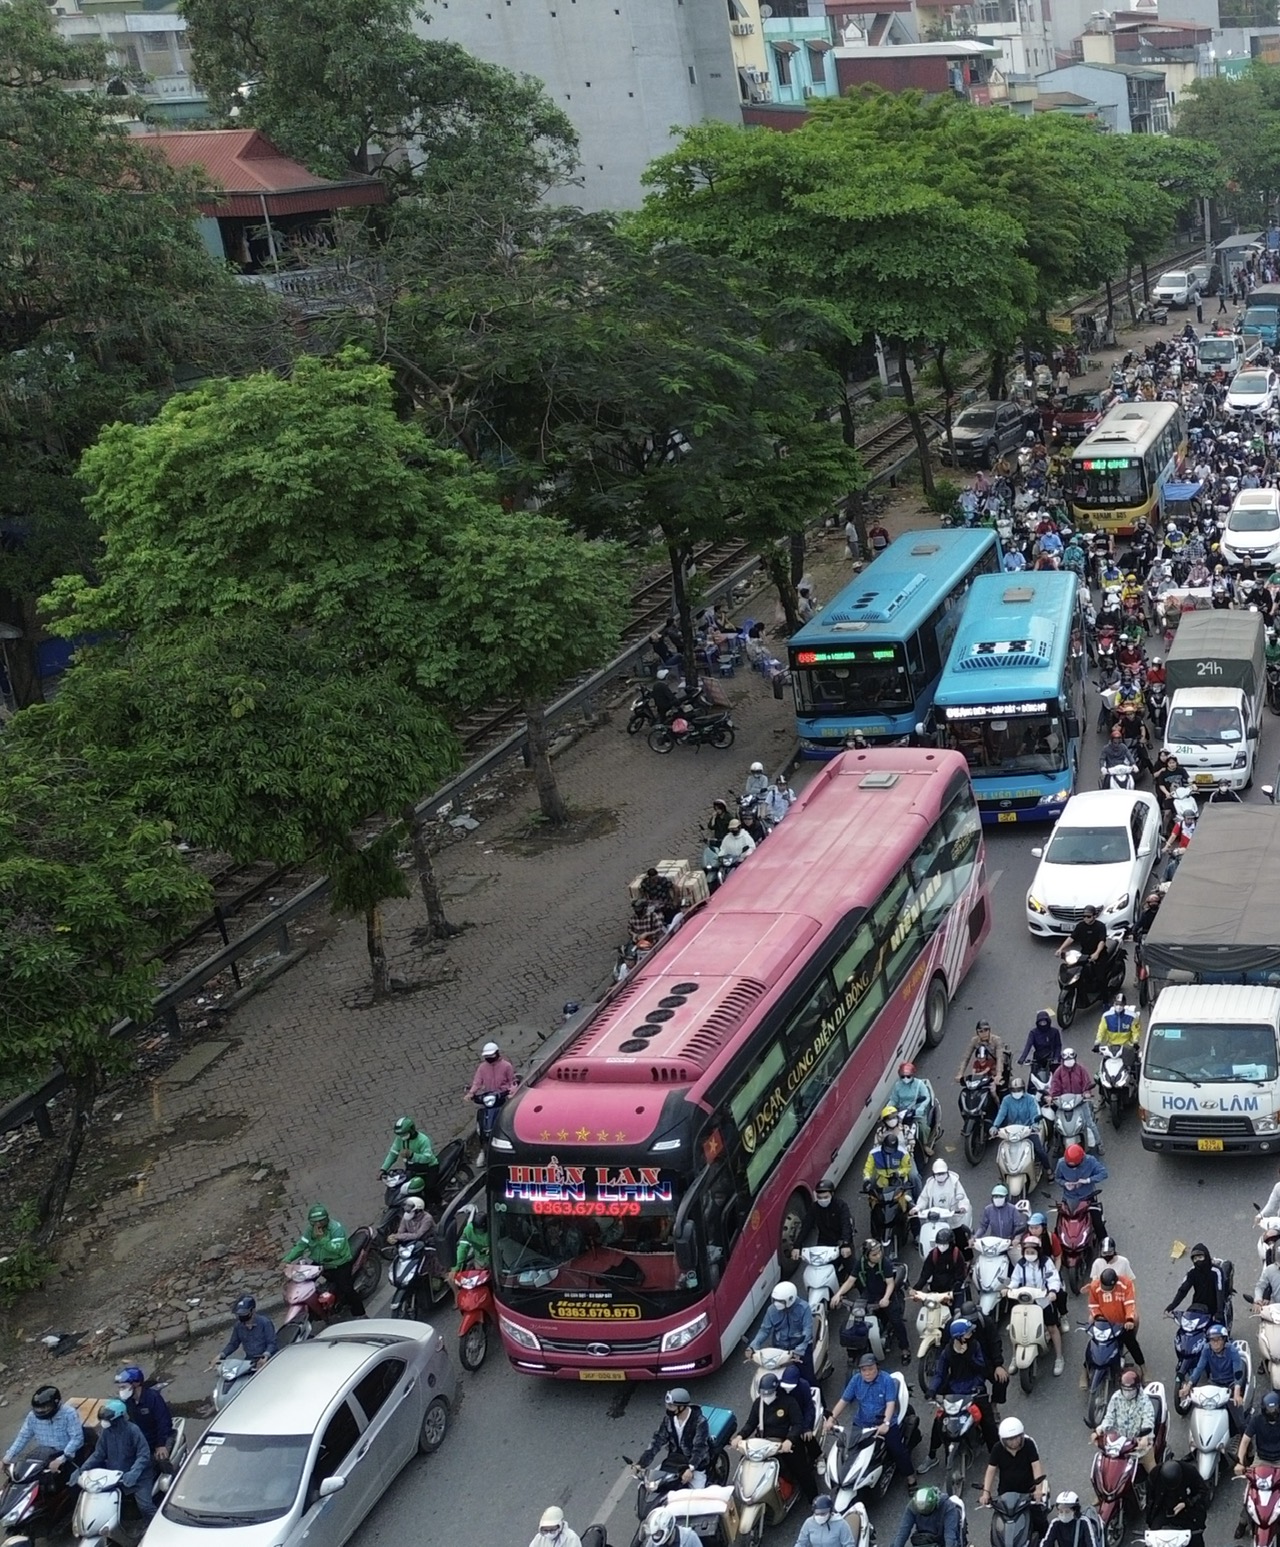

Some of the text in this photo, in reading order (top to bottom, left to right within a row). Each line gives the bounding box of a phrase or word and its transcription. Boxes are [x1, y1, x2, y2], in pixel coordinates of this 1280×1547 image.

[1197, 661, 1223, 675] 24h
[1175, 745, 1193, 754] 24h
[787, 1049, 814, 1091] CUNG
[1162, 1095, 1258, 1111] HOA LÂM
[508, 1155, 661, 1187] HIỀN LAN
[533, 1201, 641, 1216] 0363.679.679
[558, 1307, 637, 1318] 0363.679.679
